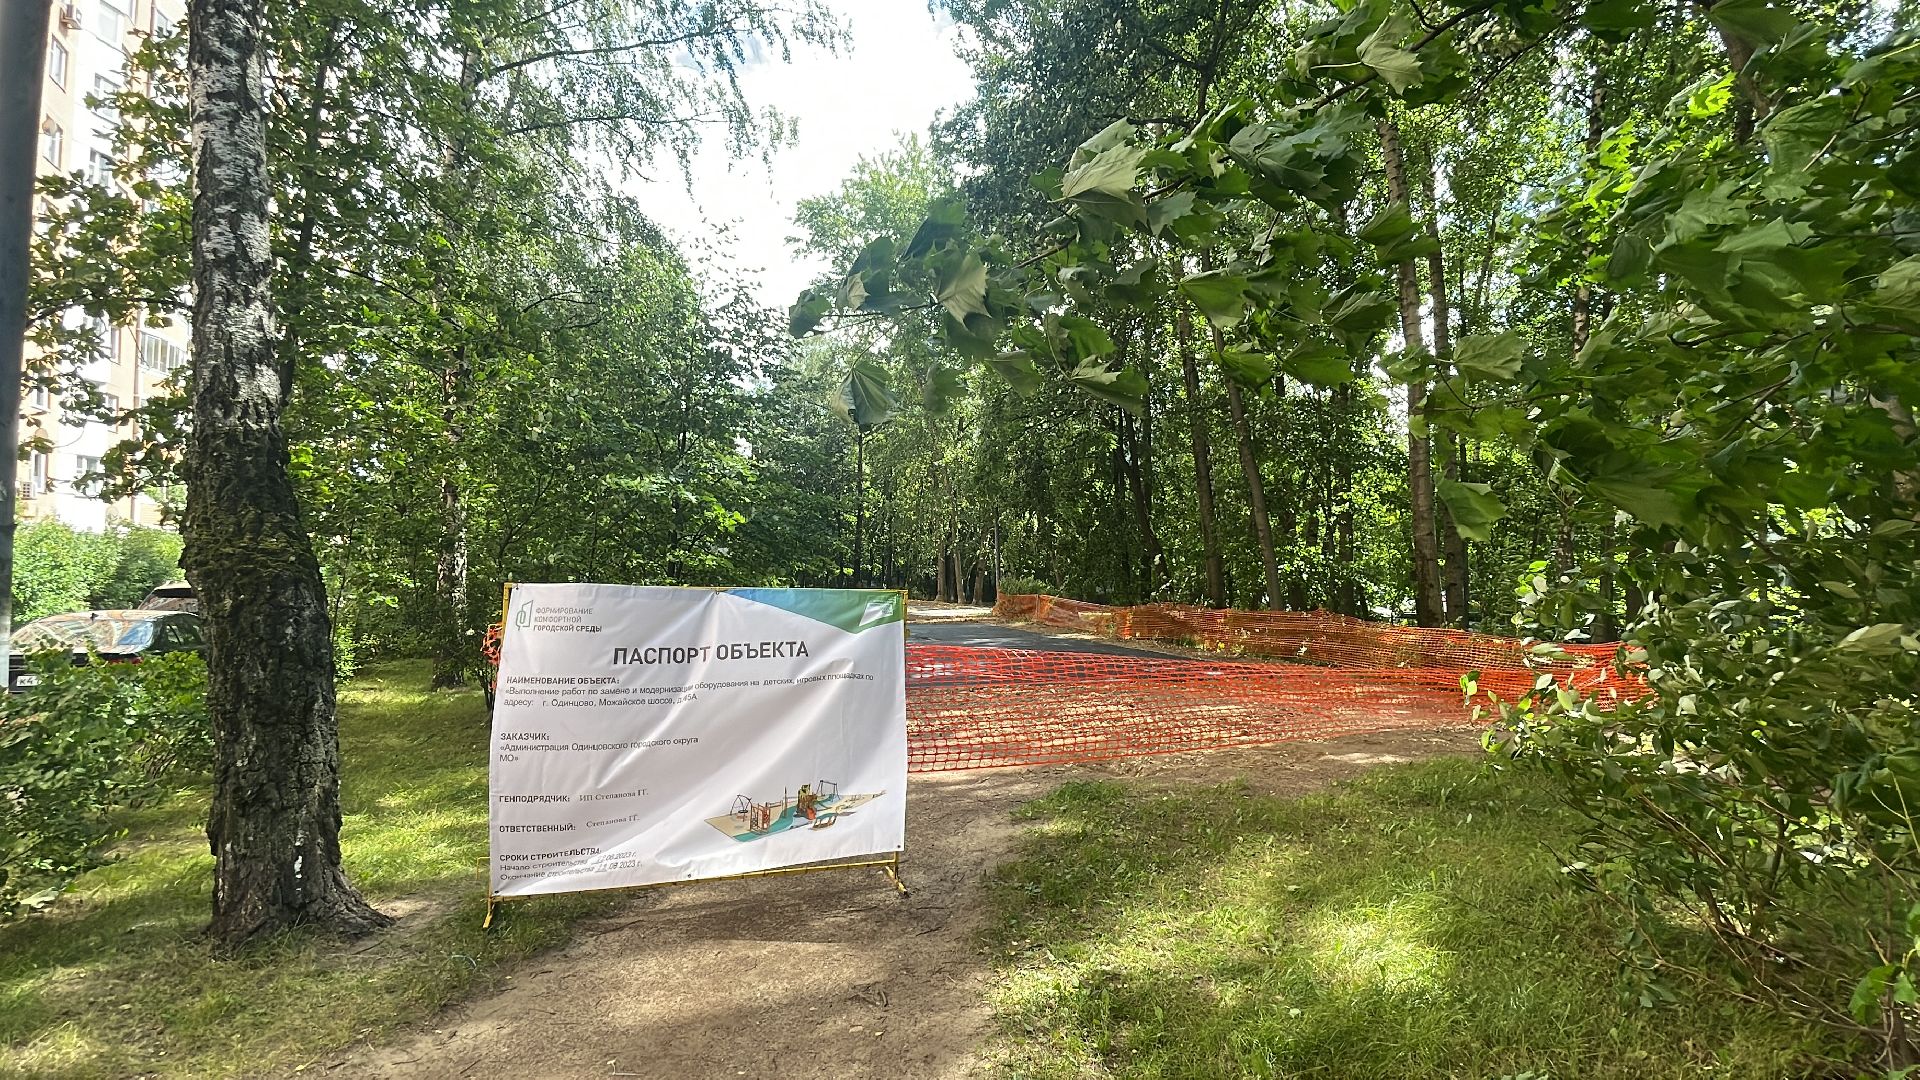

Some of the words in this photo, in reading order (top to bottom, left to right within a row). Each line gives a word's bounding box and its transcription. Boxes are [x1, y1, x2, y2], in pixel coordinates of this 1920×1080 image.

[535, 607, 593, 615] ФОРМИРОВАНИЕ
[534, 615, 582, 623] КОМФОРТНОЙ
[533, 624, 574, 632] ГОРОДСКОЙ
[613, 645, 711, 665] ПАСПОРТ
[716, 640, 809, 661] ОБЪЕКТА
[505, 686, 560, 695] «Выполнение
[561, 687, 586, 696] работ
[600, 687, 631, 695] замене
[695, 681, 749, 690] оборудования
[797, 674, 826, 684] игровых
[827, 671, 865, 680] площадках
[506, 676, 575, 684] НАИМЕНОВАНИЕ
[577, 677, 620, 685] ОБЪЕКТА:
[504, 698, 534, 707] адресу:
[551, 698, 597, 707] Одинцово,
[598, 697, 646, 706] Можайское
[647, 697, 676, 705] шоссе,
[500, 732, 550, 740] ЗАКАЗЧИК:
[500, 743, 569, 752] «Администрация
[571, 742, 628, 751] Одинцовского
[630, 738, 672, 749] городского
[673, 737, 699, 746] округа
[499, 753, 519, 762] МО»
[499, 795, 570, 803] ГЕНПОДРЯДЧИК:
[579, 794, 593, 802] ИП
[595, 791, 636, 800] Степанова
[499, 823, 576, 832] ОТВЕТСТВЕННЫЙ:
[586, 816, 627, 828] Степанова
[499, 854, 529, 862] СРОКИ
[500, 871, 546, 880] Окончание
